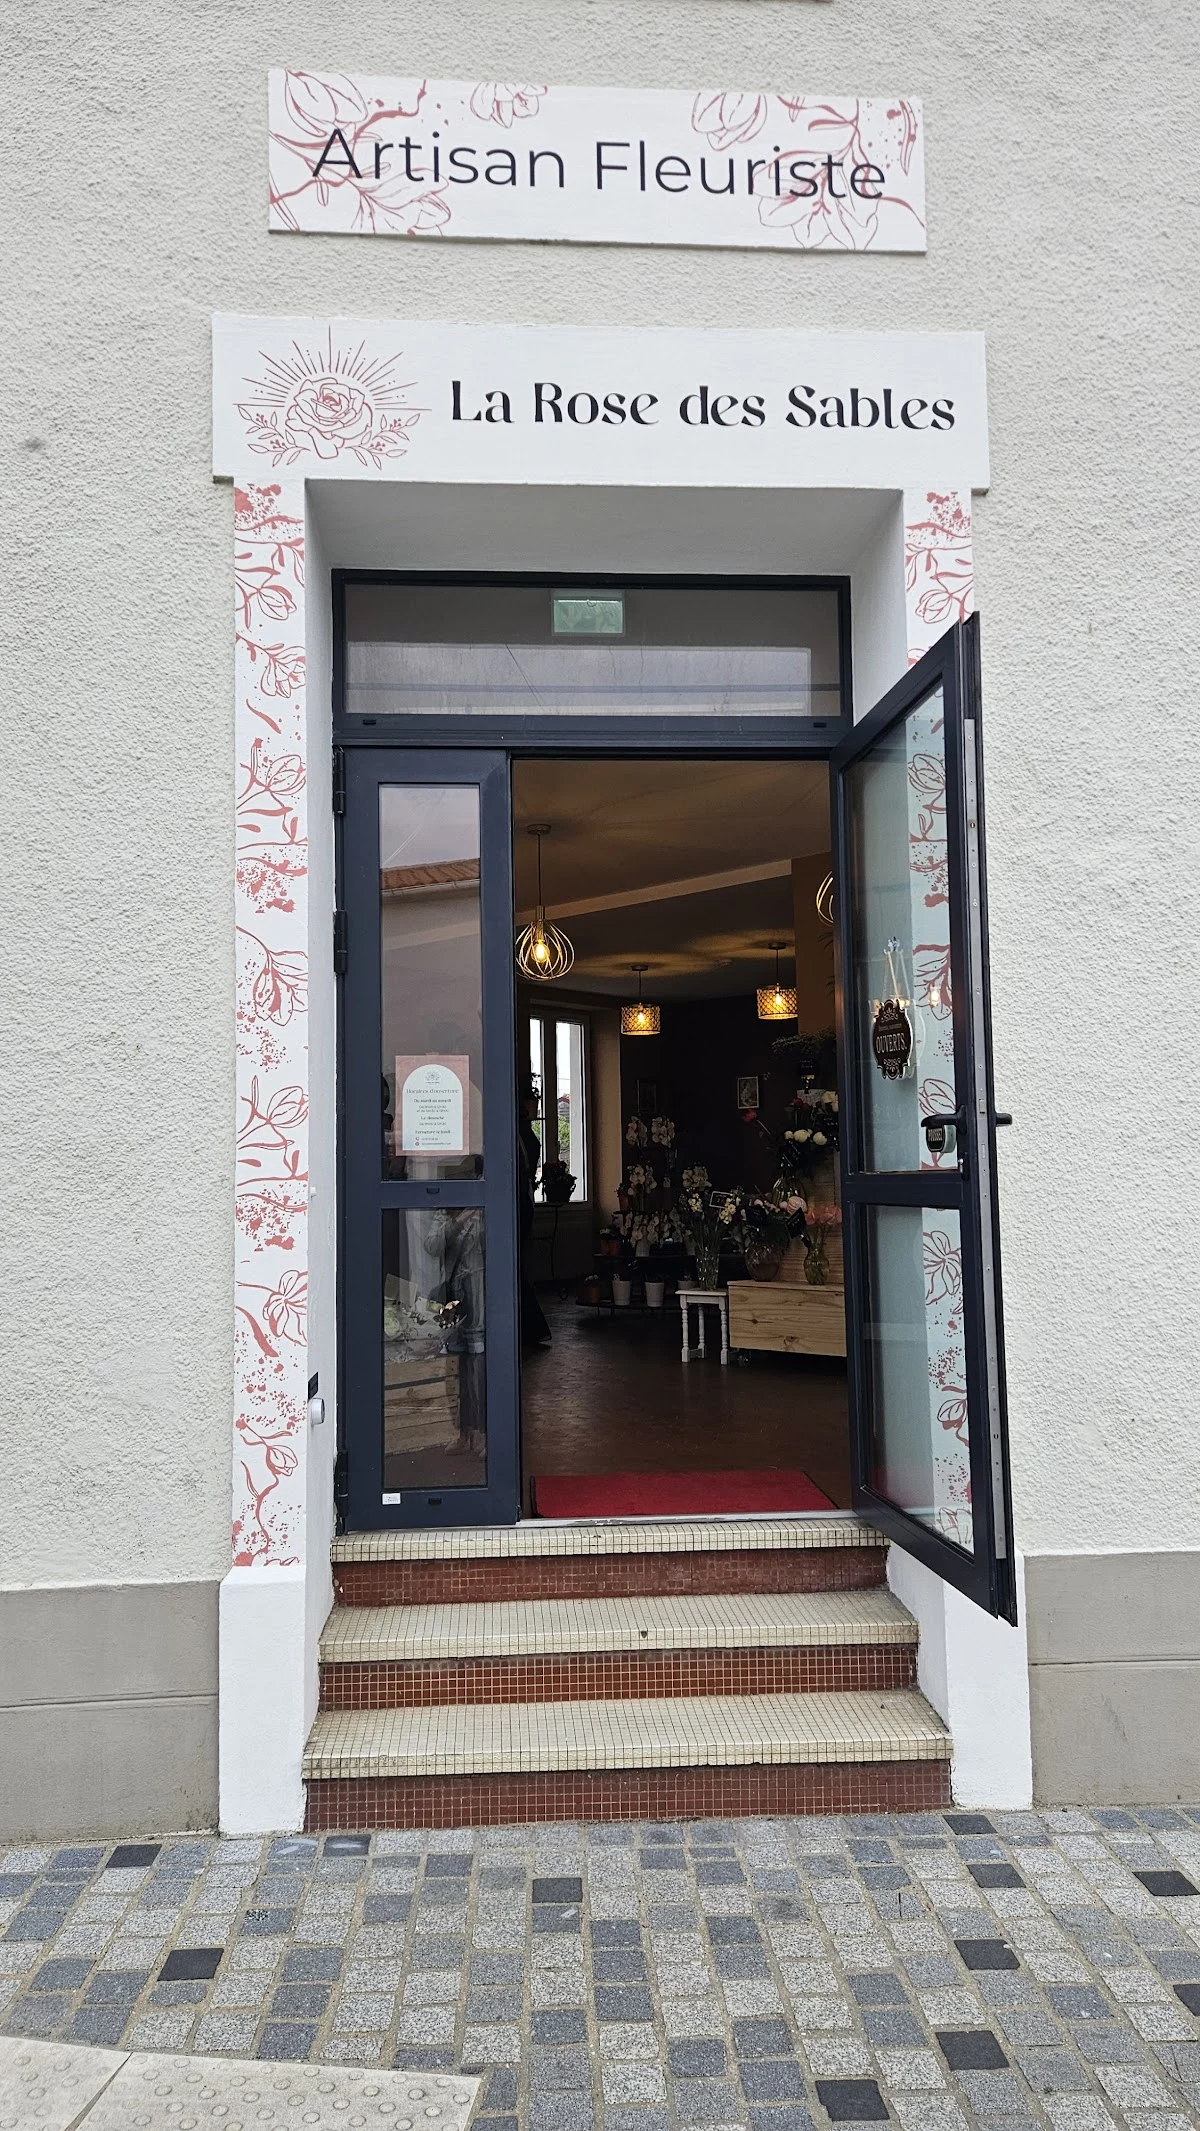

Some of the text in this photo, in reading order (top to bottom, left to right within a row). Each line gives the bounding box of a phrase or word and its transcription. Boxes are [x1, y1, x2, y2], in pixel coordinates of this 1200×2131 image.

[312, 128, 886, 200] Artisan Fleuriste
[452, 380, 955, 430] La Rose des Sables
